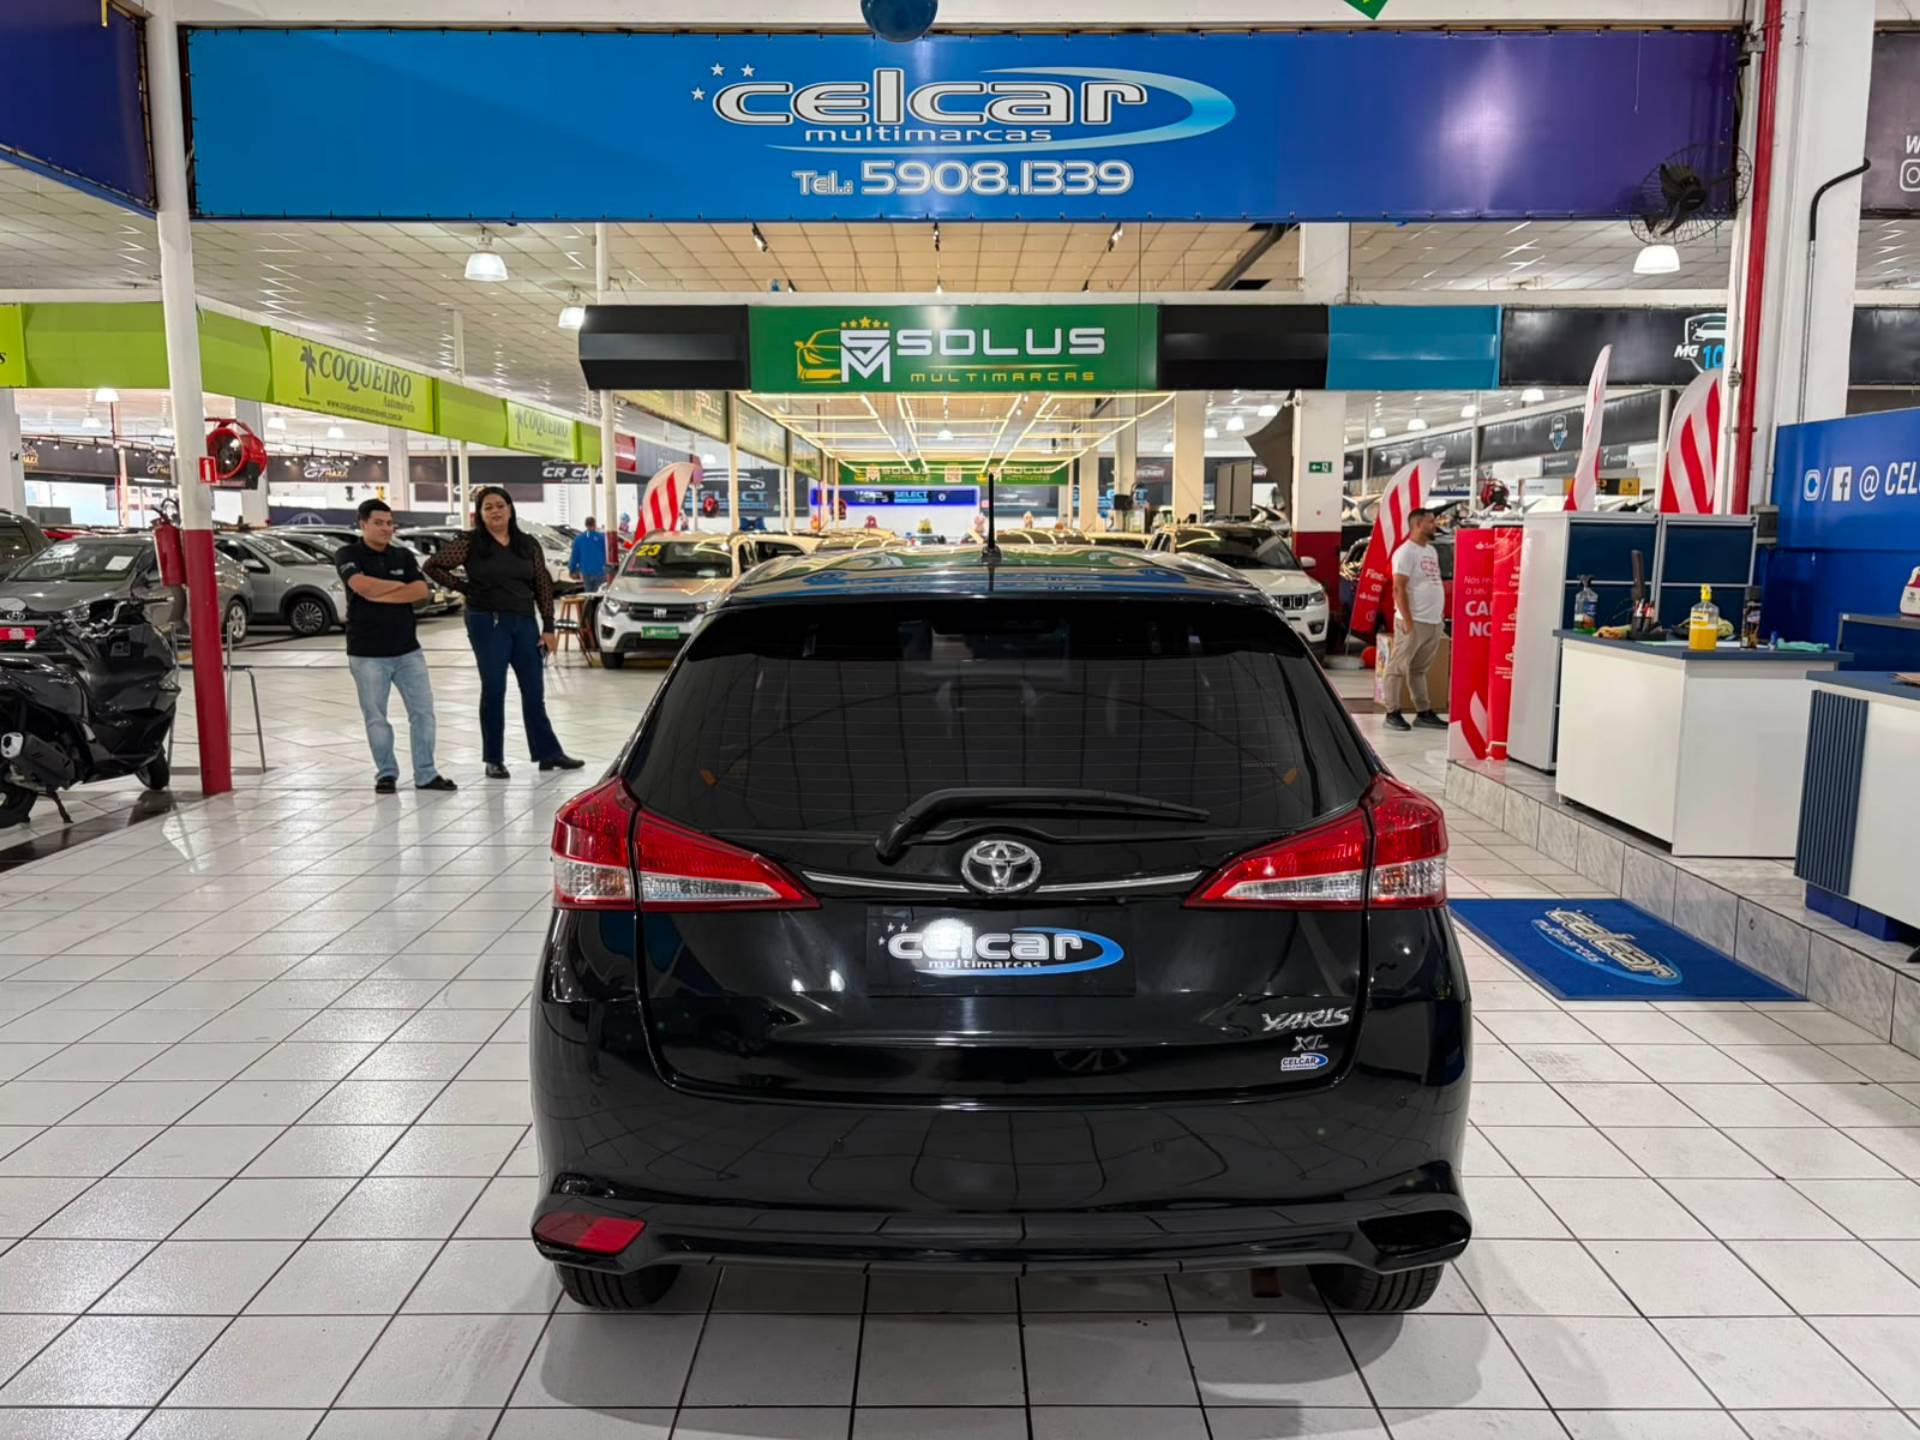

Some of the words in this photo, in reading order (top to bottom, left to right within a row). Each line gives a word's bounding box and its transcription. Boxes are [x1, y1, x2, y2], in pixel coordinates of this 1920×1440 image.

[712, 67, 1148, 126] celcar
[804, 126, 1052, 143] multimarcas
[860, 160, 1135, 196] 5908.1339
[896, 327, 1105, 356] SOLUS
[1673, 344, 1700, 358] MG
[318, 350, 412, 399] COQUEIRO
[910, 371, 1097, 383] MULTIMARCAS
[523, 408, 569, 438] COQUEIRO
[542, 466, 567, 478] CR
[1884, 461, 1920, 496] CEL
[636, 544, 662, 557] 23
[888, 926, 1084, 960] celcar
[928, 959, 1042, 970] multimarcas
[1261, 1006, 1353, 1031] YARIS
[1291, 1034, 1329, 1052] XL
[1282, 1055, 1319, 1066] CELCAR
